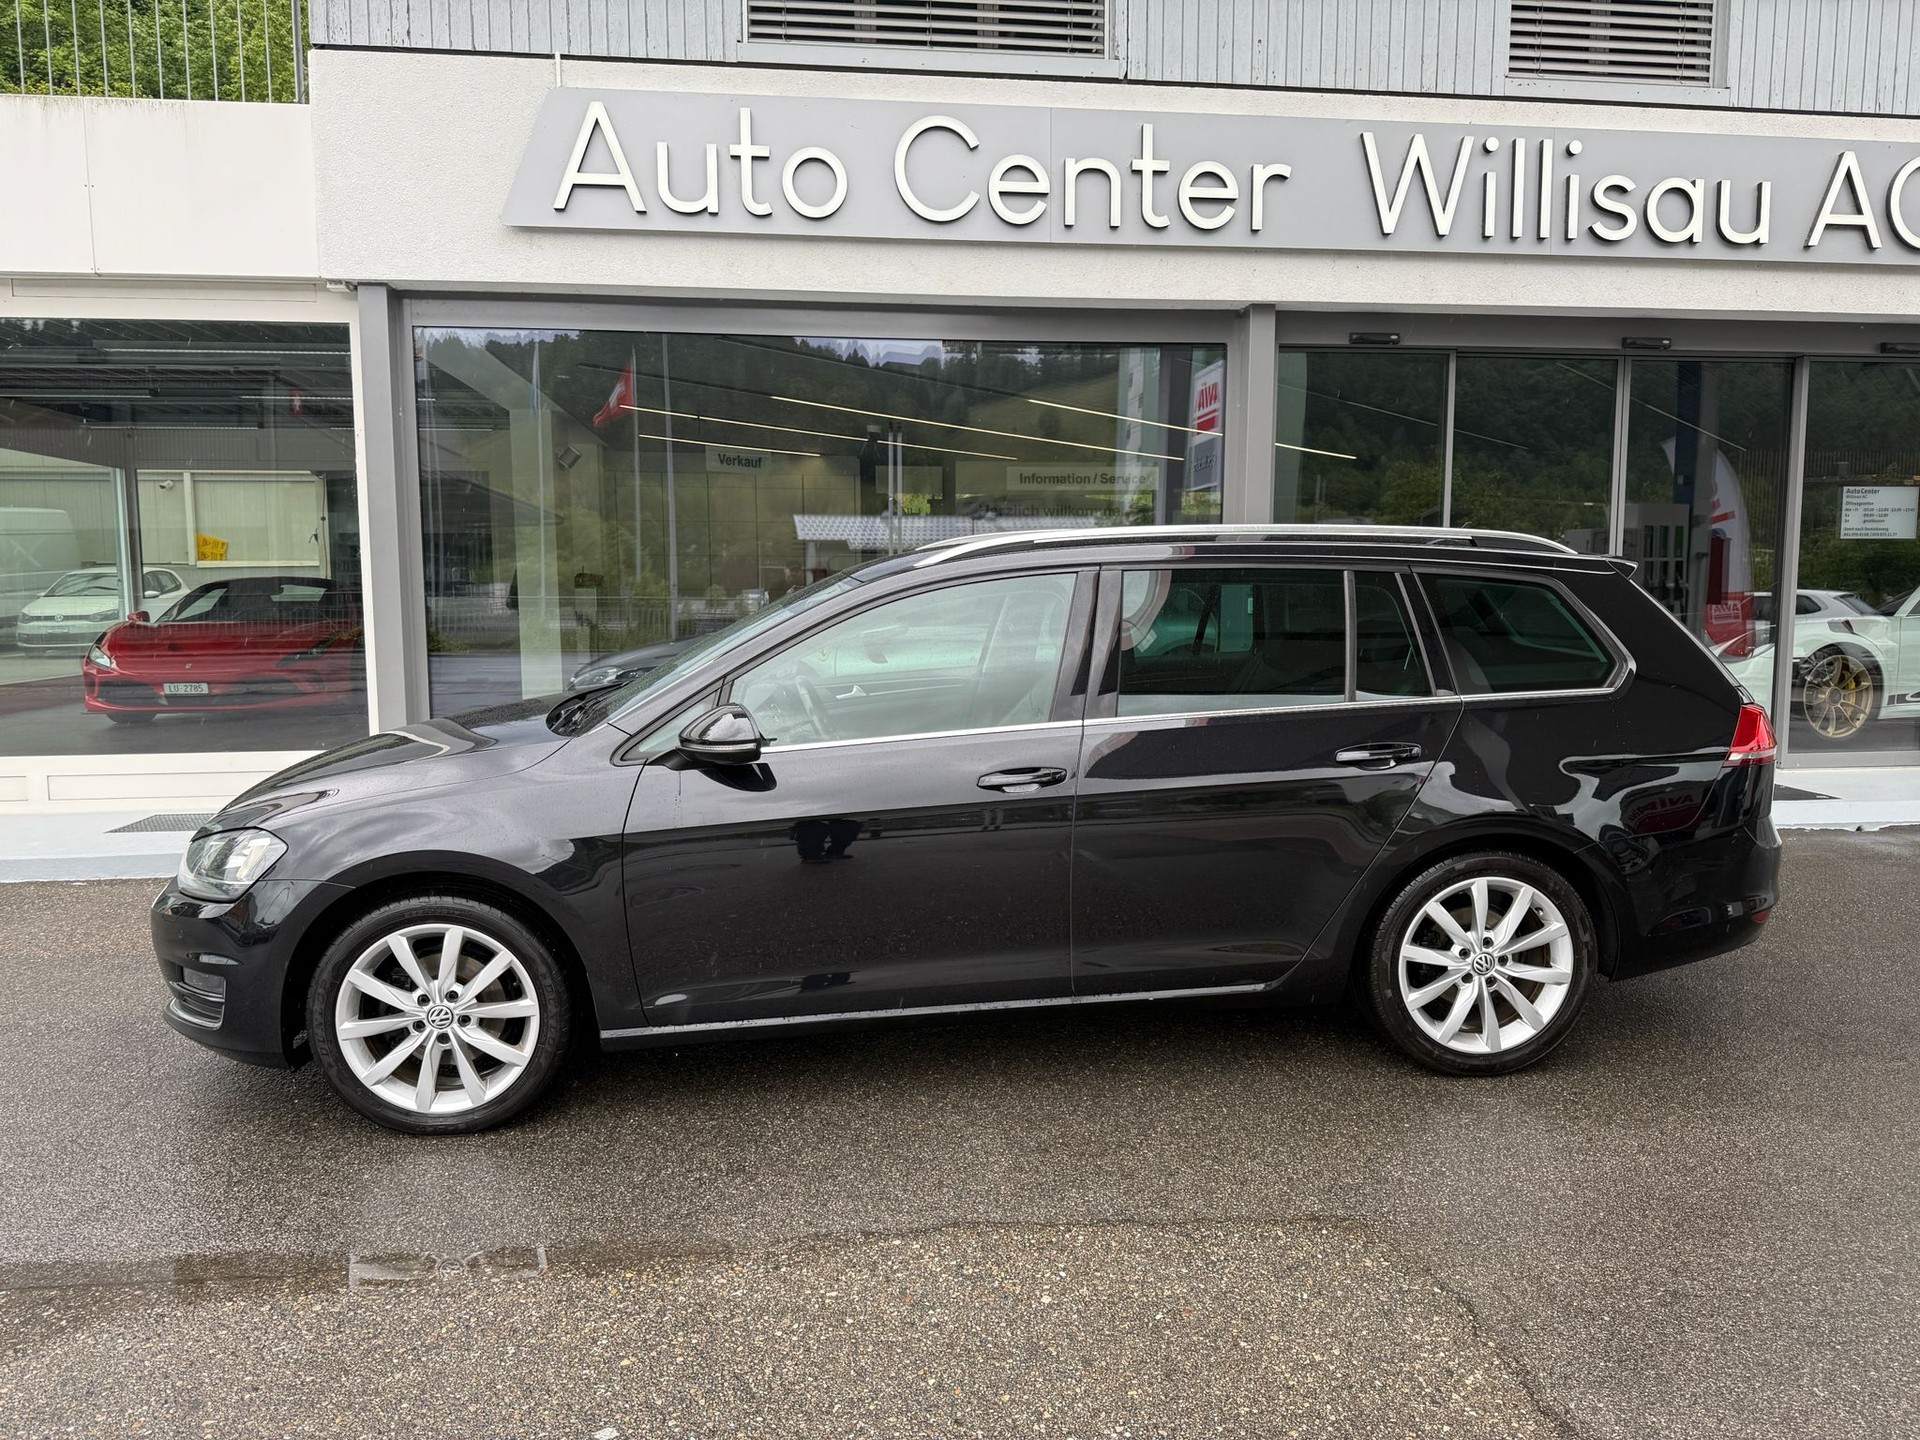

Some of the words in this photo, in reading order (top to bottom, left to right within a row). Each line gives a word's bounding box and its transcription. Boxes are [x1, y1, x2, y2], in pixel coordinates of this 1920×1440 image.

[552, 101, 848, 219] Auto
[893, 115, 1292, 231] Center
[1361, 131, 1772, 245] Willisau
[718, 453, 762, 469] Verkauf
[1019, 473, 1091, 484] Information
